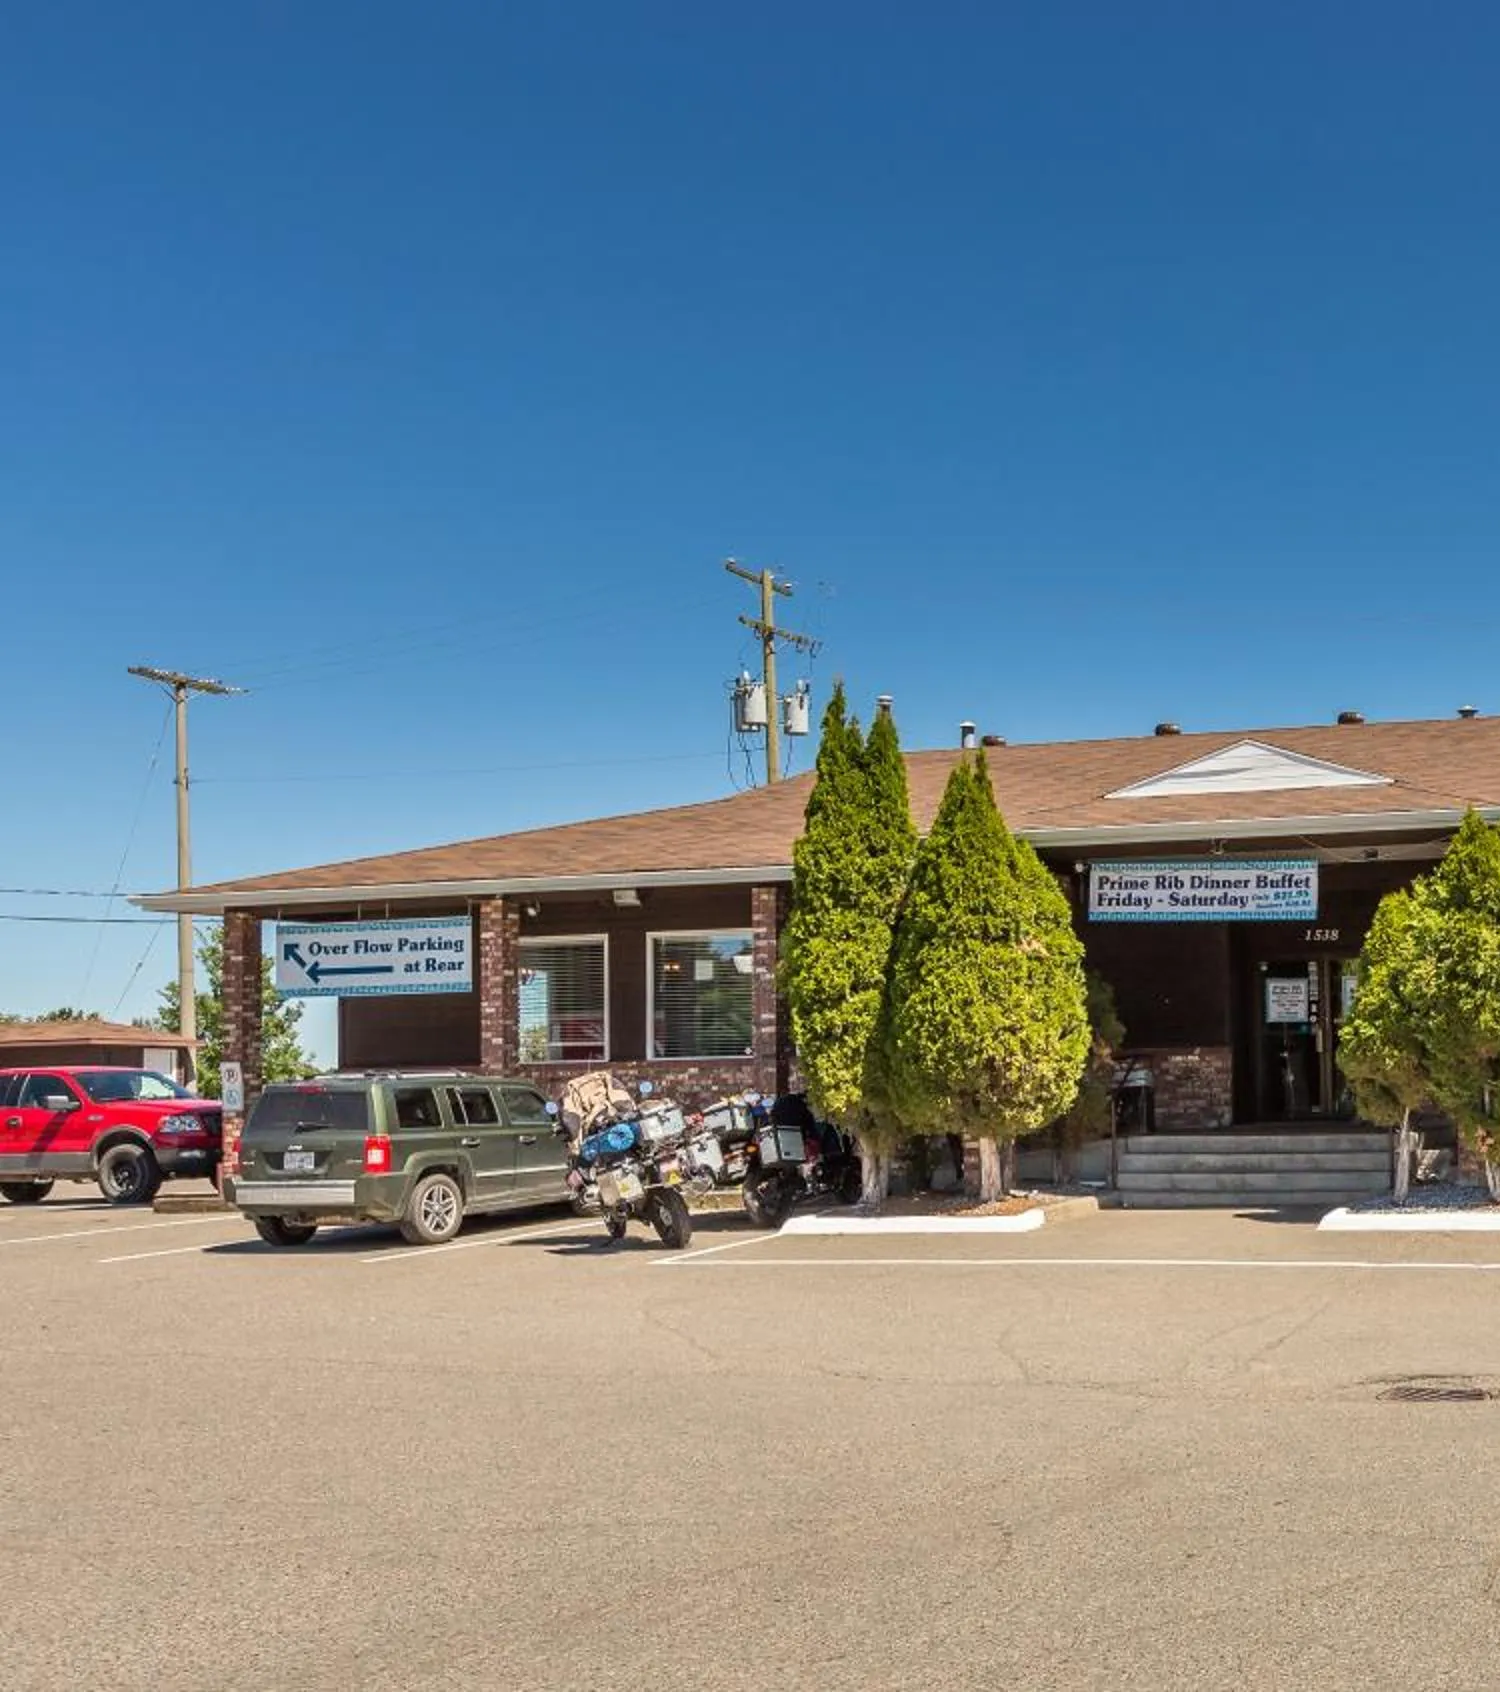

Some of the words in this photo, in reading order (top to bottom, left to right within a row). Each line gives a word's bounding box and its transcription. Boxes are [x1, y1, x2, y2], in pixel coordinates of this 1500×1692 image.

[1097, 875, 1150, 891] Prime
[1155, 875, 1186, 891] Rib
[1190, 874, 1250, 890] Dinner
[1255, 873, 1311, 890] Buffet
[1097, 892, 1152, 909] Friday
[1168, 892, 1249, 909] Saturday
[1305, 929, 1340, 941] 1538
[308, 942, 349, 956] Over
[353, 940, 393, 955] Flow
[398, 936, 465, 953] Parking
[404, 962, 420, 973] at
[425, 957, 465, 972] Rear
